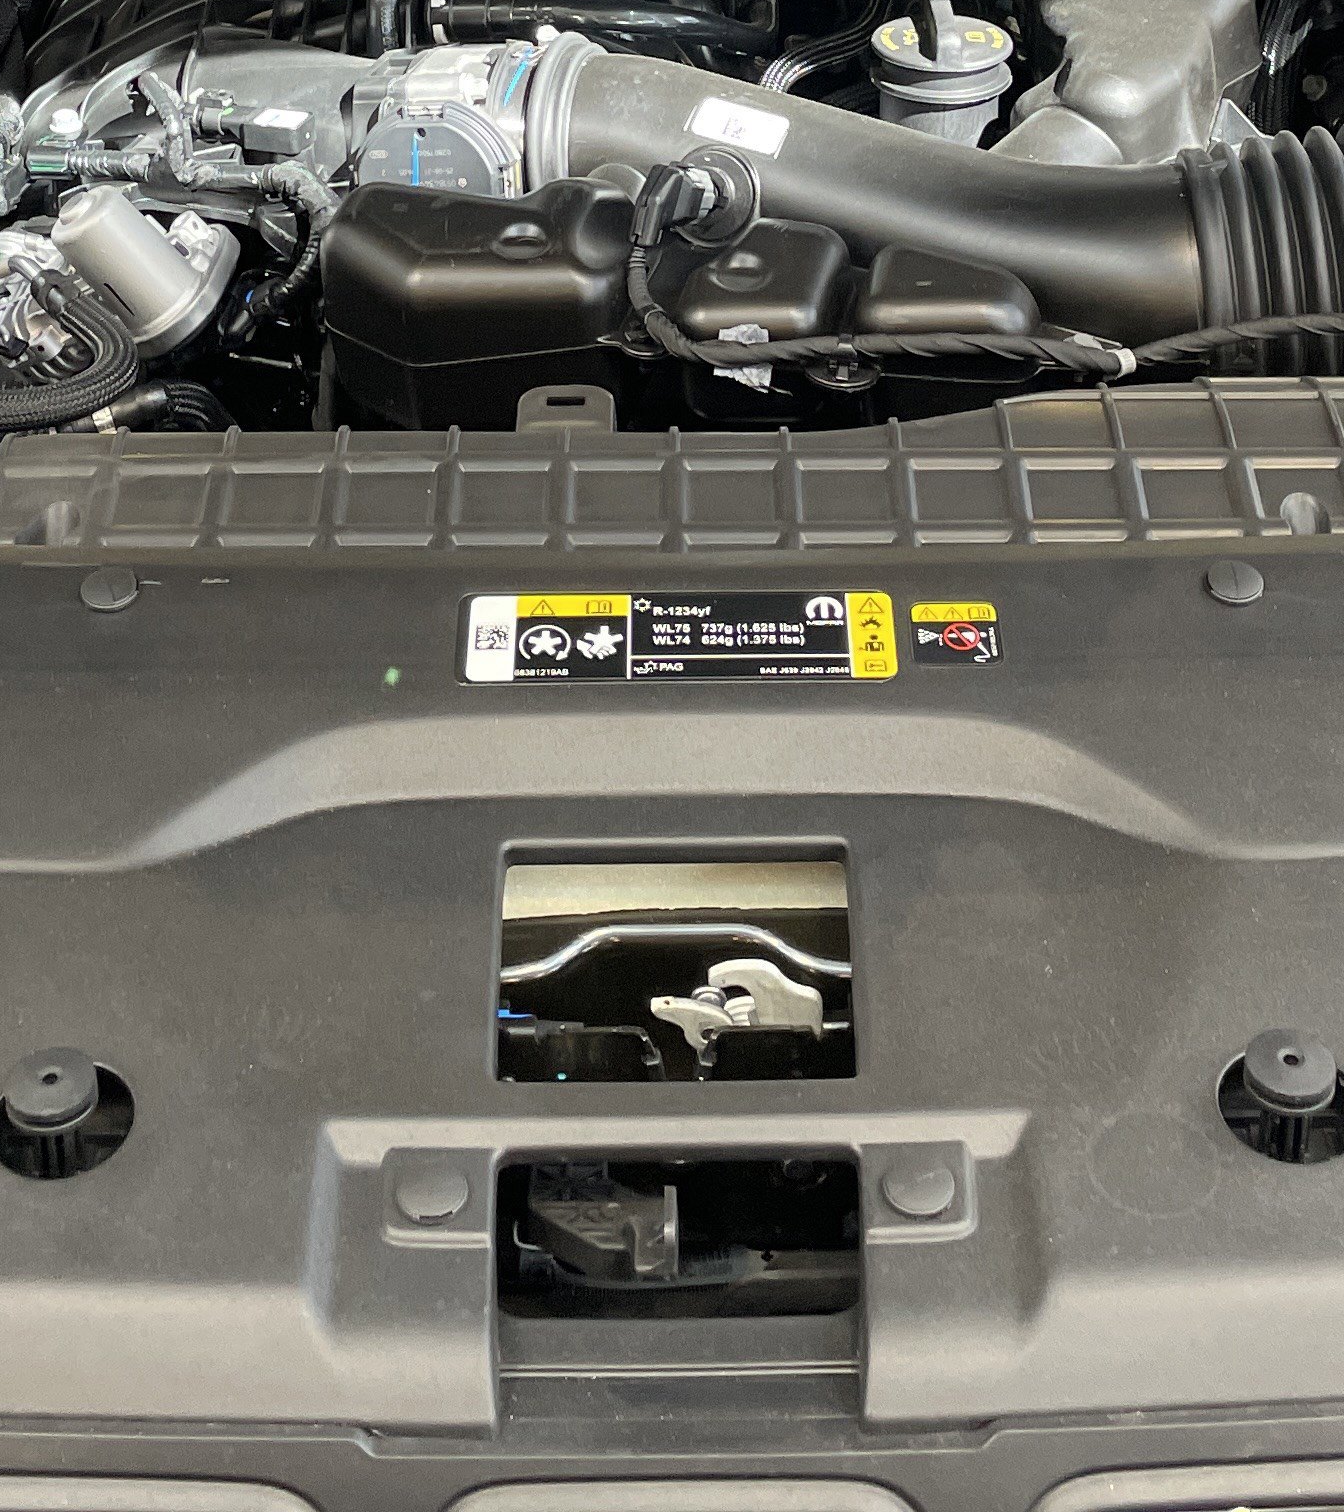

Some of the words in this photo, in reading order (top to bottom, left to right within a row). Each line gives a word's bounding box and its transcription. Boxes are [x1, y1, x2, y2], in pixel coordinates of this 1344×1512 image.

[652, 605, 712, 618] R-1234yf
[700, 622, 734, 635] 737g
[736, 622, 777, 635] (1.625
[652, 635, 691, 646] WL74
[659, 662, 684, 672] PAG
